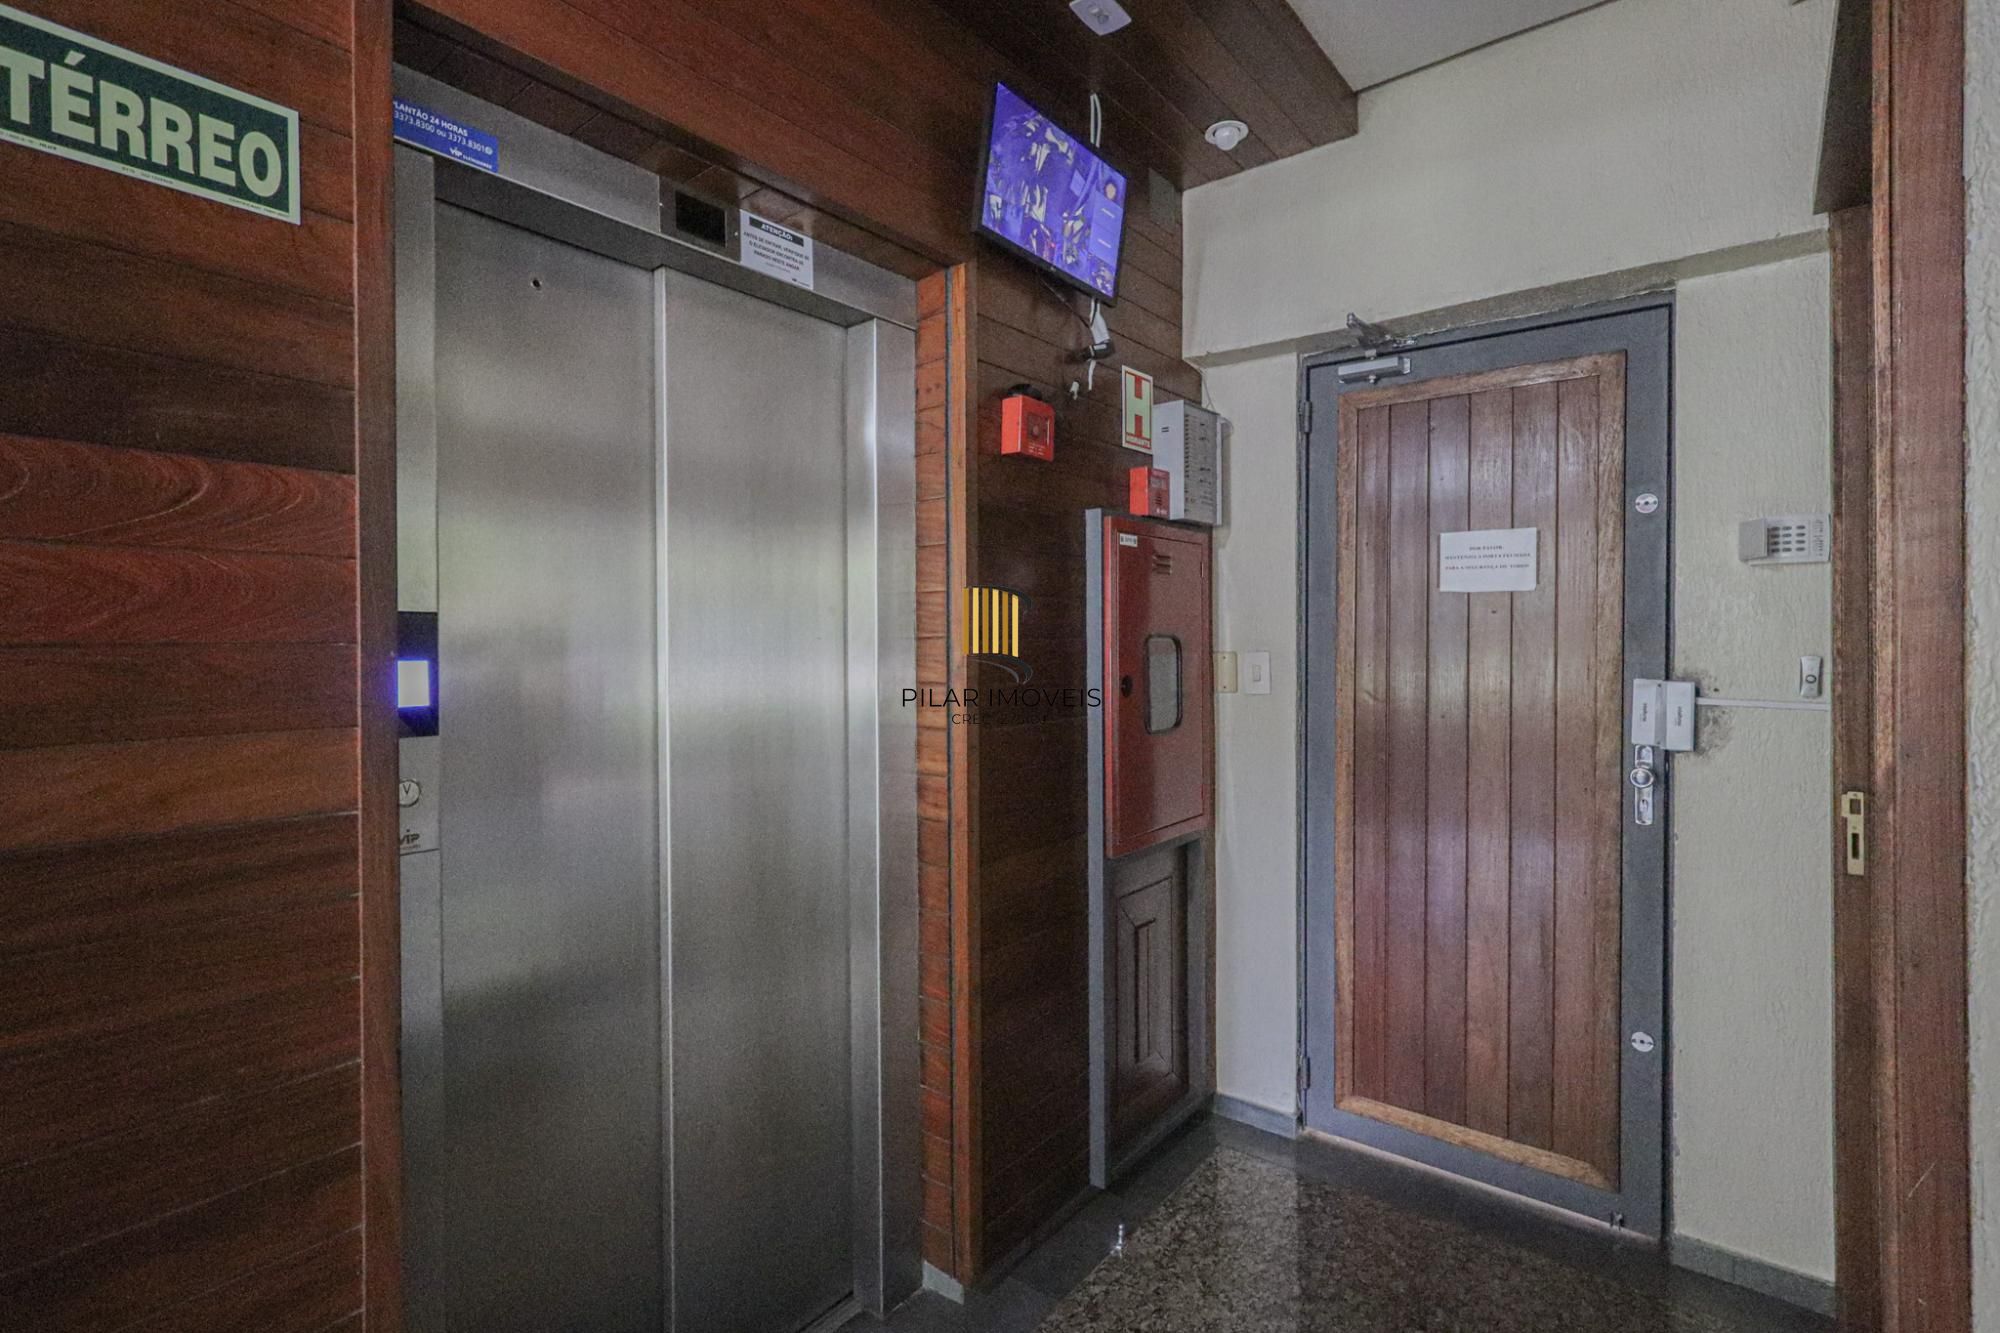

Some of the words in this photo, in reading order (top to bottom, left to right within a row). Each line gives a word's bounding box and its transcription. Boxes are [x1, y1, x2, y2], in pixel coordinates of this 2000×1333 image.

[0, 45, 282, 198] TÉRREO
[430, 115, 440, 125] 24
[441, 120, 468, 137] HORAS
[436, 128, 447, 138] ou
